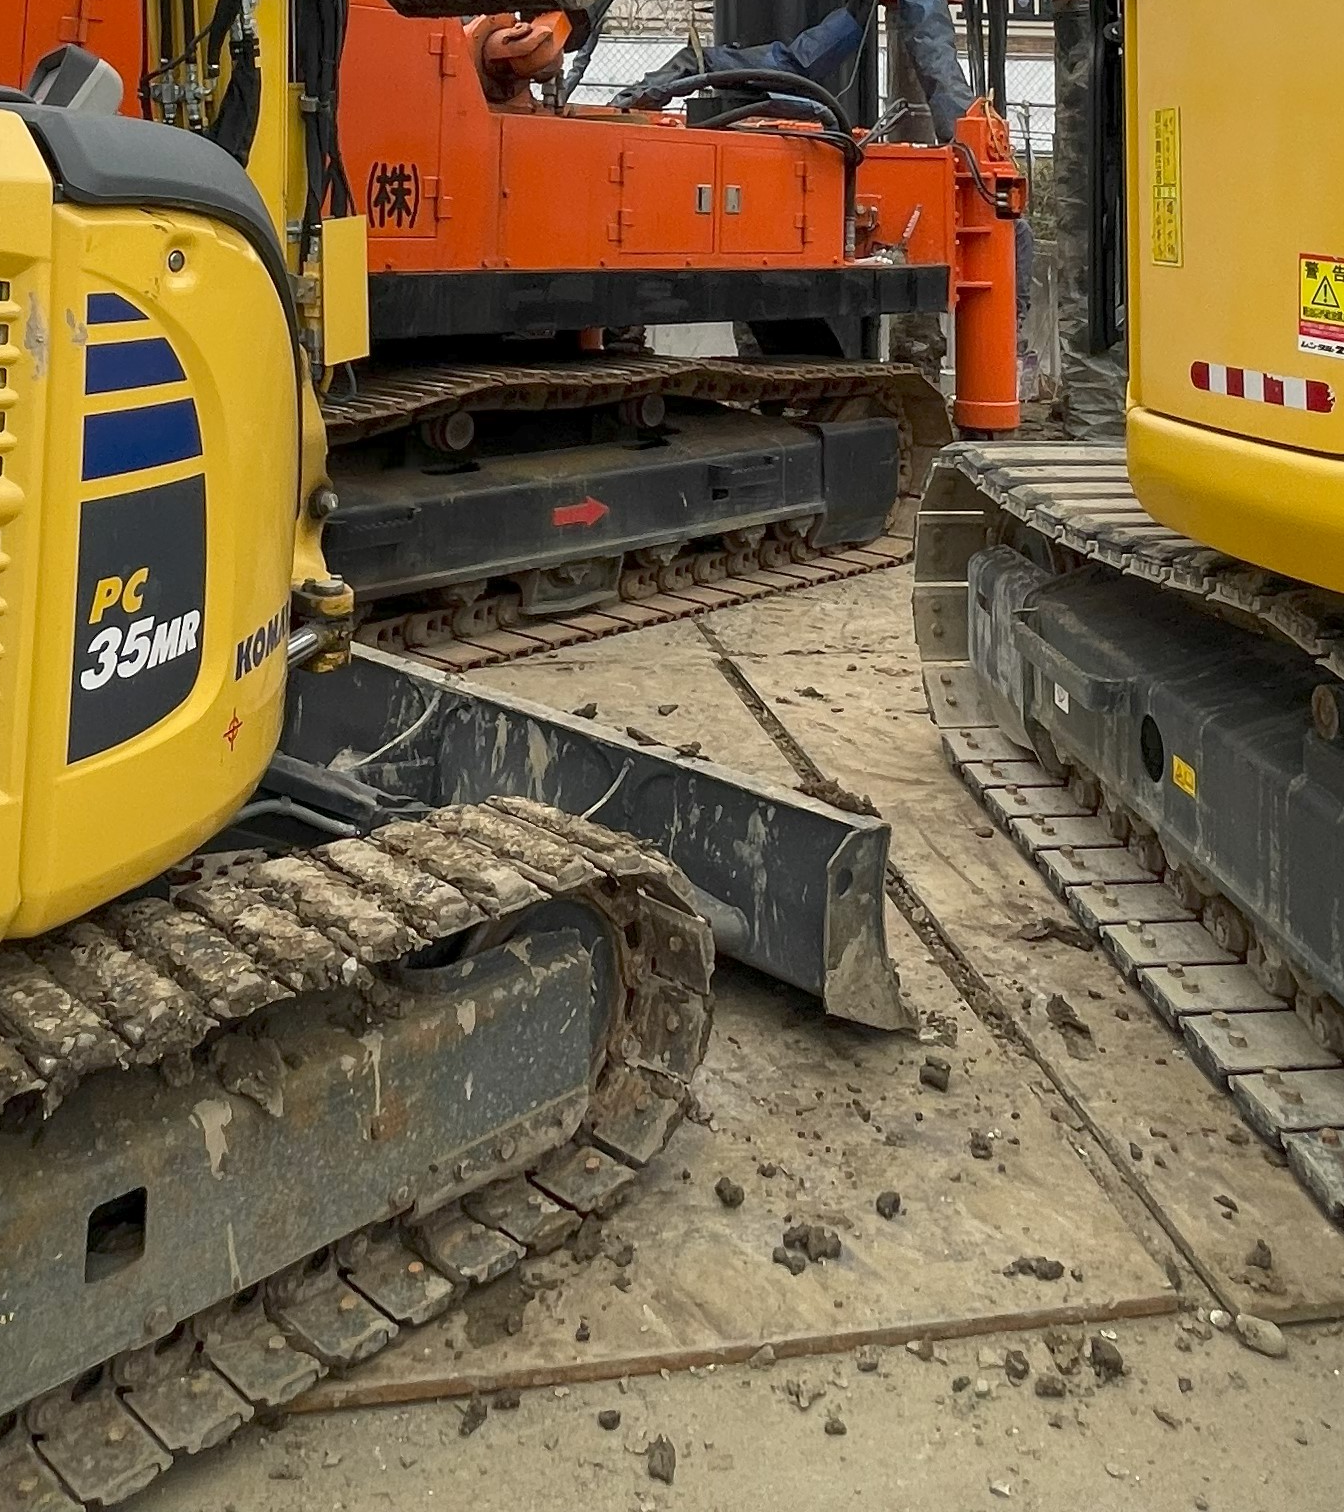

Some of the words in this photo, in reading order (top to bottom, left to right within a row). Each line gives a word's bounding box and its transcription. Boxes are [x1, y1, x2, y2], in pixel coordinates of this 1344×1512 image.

[88, 567, 149, 625] PC
[80, 609, 201, 691] 35MR
[235, 600, 291, 682] KOMA
